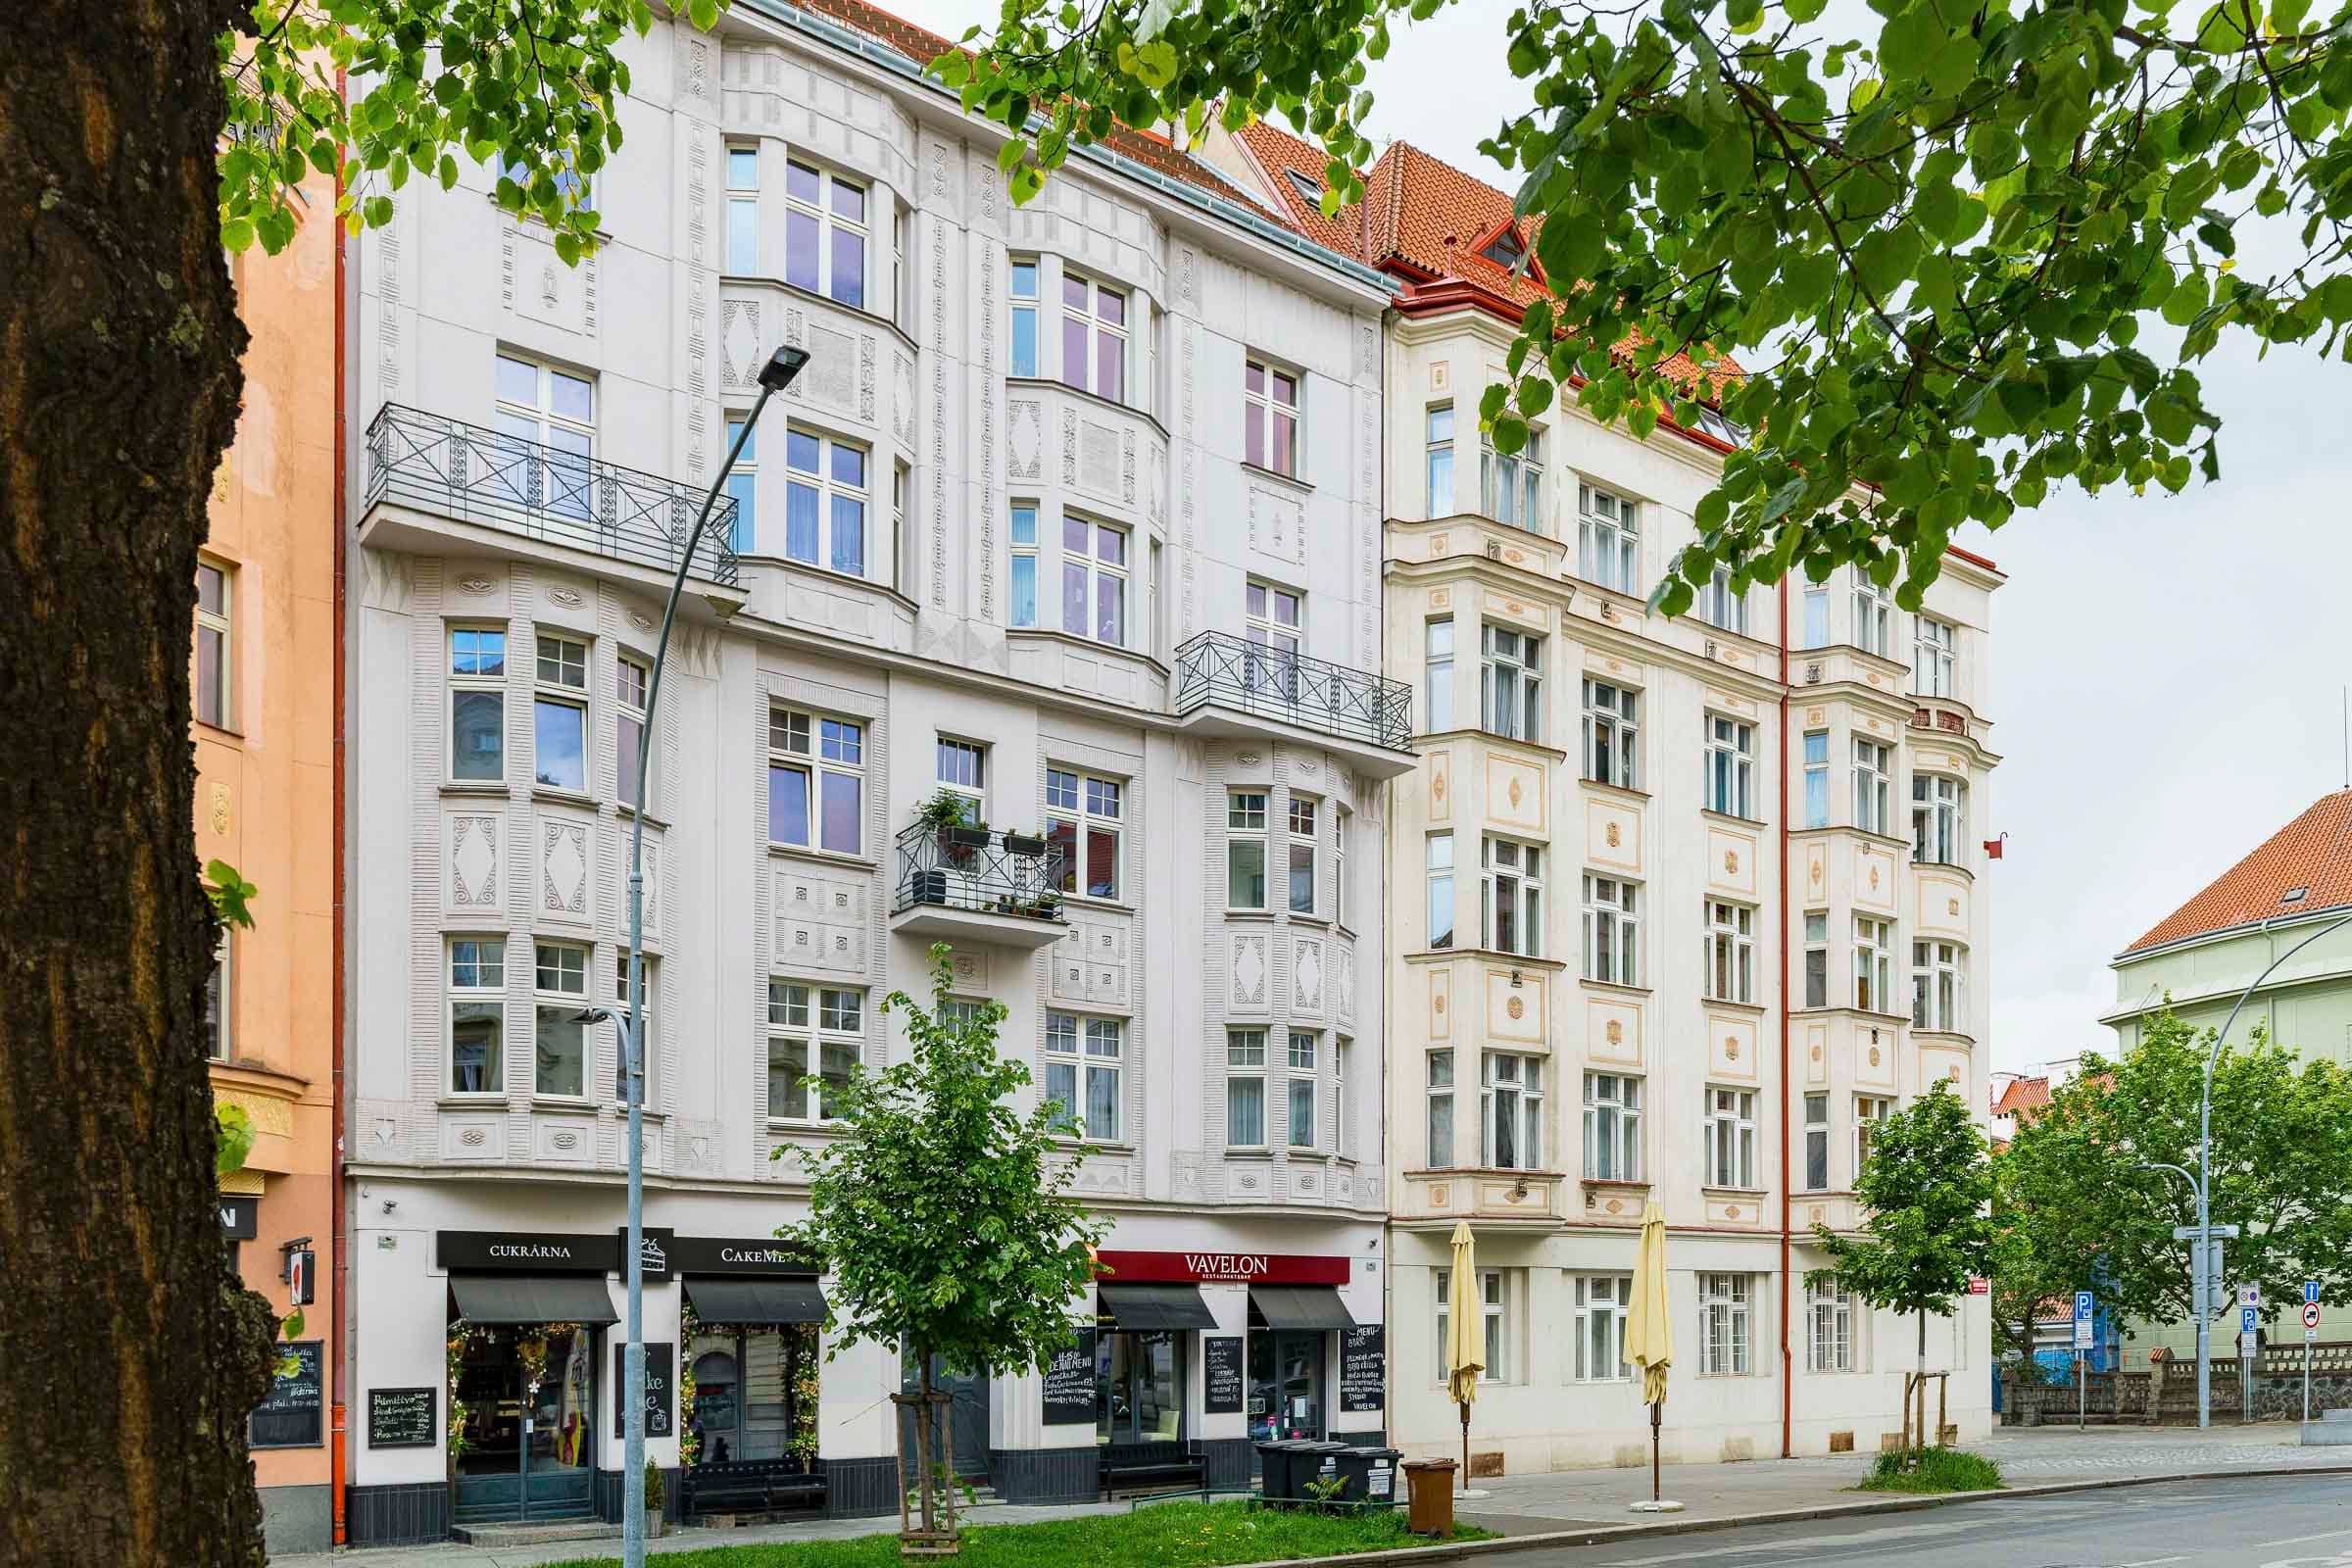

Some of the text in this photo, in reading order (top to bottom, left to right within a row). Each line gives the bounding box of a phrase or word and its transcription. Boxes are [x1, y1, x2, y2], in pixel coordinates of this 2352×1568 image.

[490, 1243, 571, 1257] CUKRÁRNA
[1184, 1254, 1268, 1274] VAVELON
[2080, 1296, 2089, 1311] P
[2244, 1310, 2254, 1325] P
[1356, 1326, 1375, 1337] MENU
[1072, 1356, 1092, 1369] MENU
